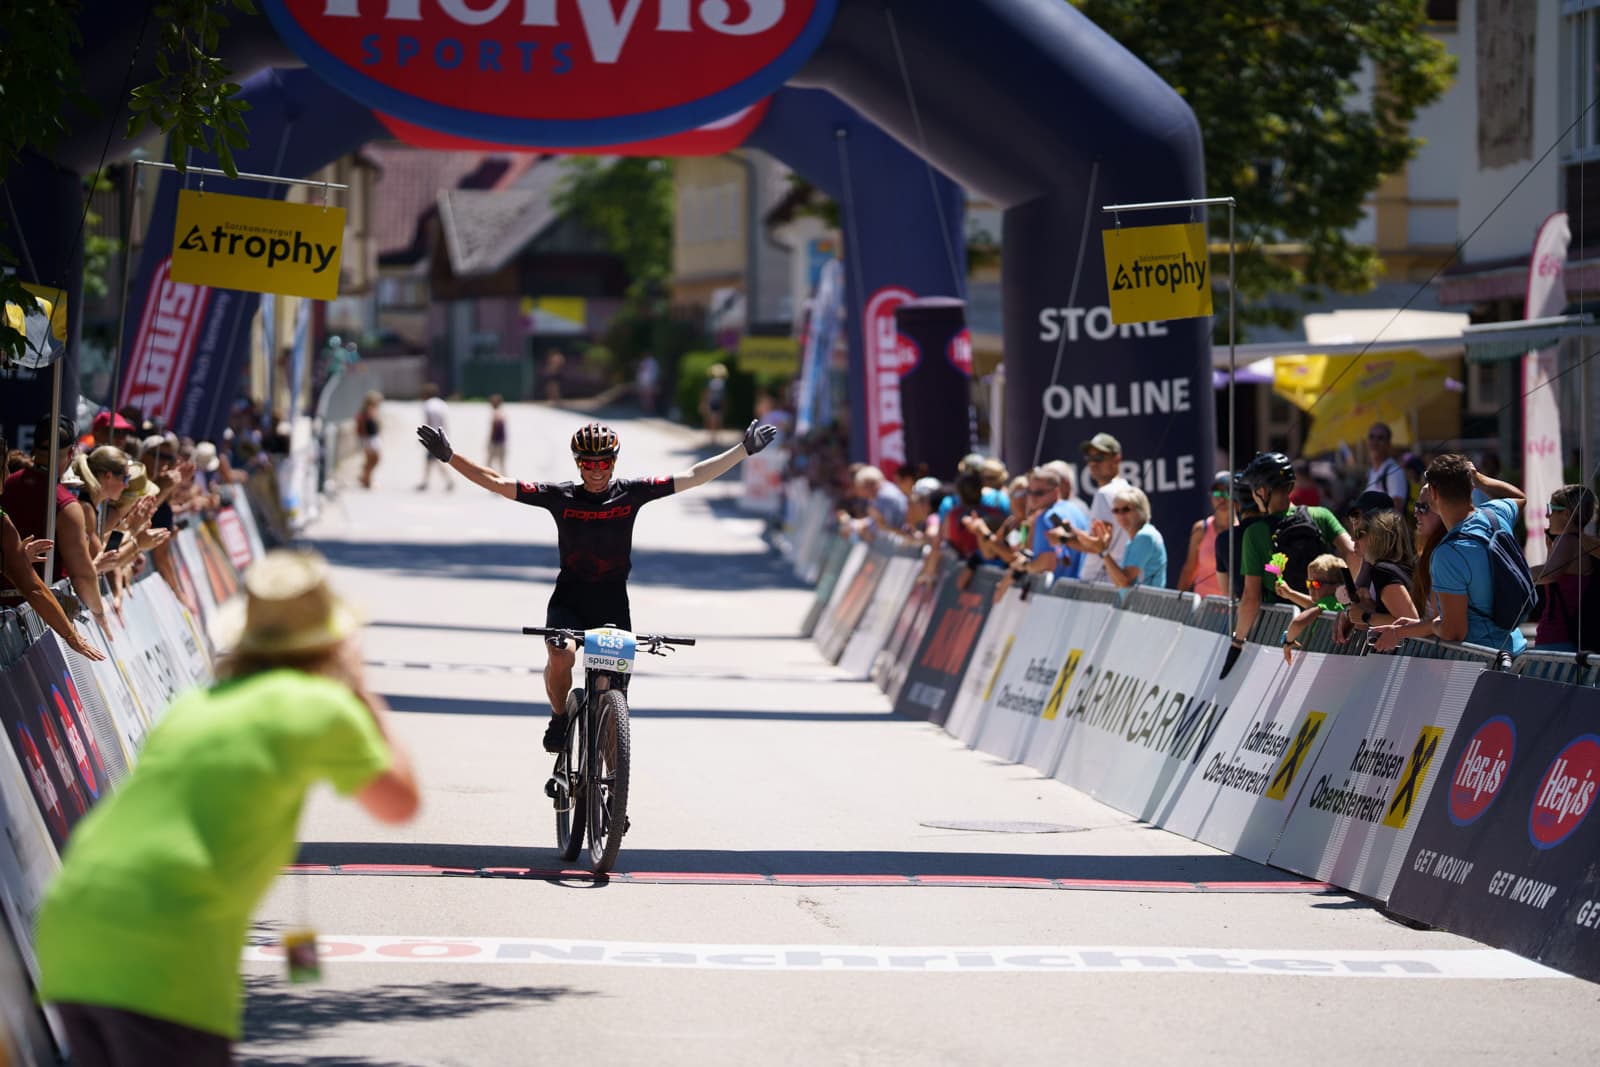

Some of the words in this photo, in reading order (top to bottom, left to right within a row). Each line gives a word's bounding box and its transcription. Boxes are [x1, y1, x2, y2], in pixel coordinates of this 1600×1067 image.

[361, 34, 574, 74] SPORTS
[212, 226, 337, 273] trophy
[1132, 252, 1206, 293] trophy
[1042, 377, 1190, 419] ONLINE
[1070, 455, 1195, 497] BILE
[588, 656, 615, 667] spusu
[597, 635, 624, 650] C33
[1242, 721, 1291, 758] Raiffeisen
[1350, 738, 1404, 780] Raiffeisen
[1202, 752, 1275, 796] Oberösterreich
[1455, 739, 1507, 801] Hervis
[1537, 758, 1596, 824] Hervis
[1309, 773, 1389, 824] Oberösterreich
[1413, 848, 1436, 874] GET
[1488, 870, 1514, 897] GET
